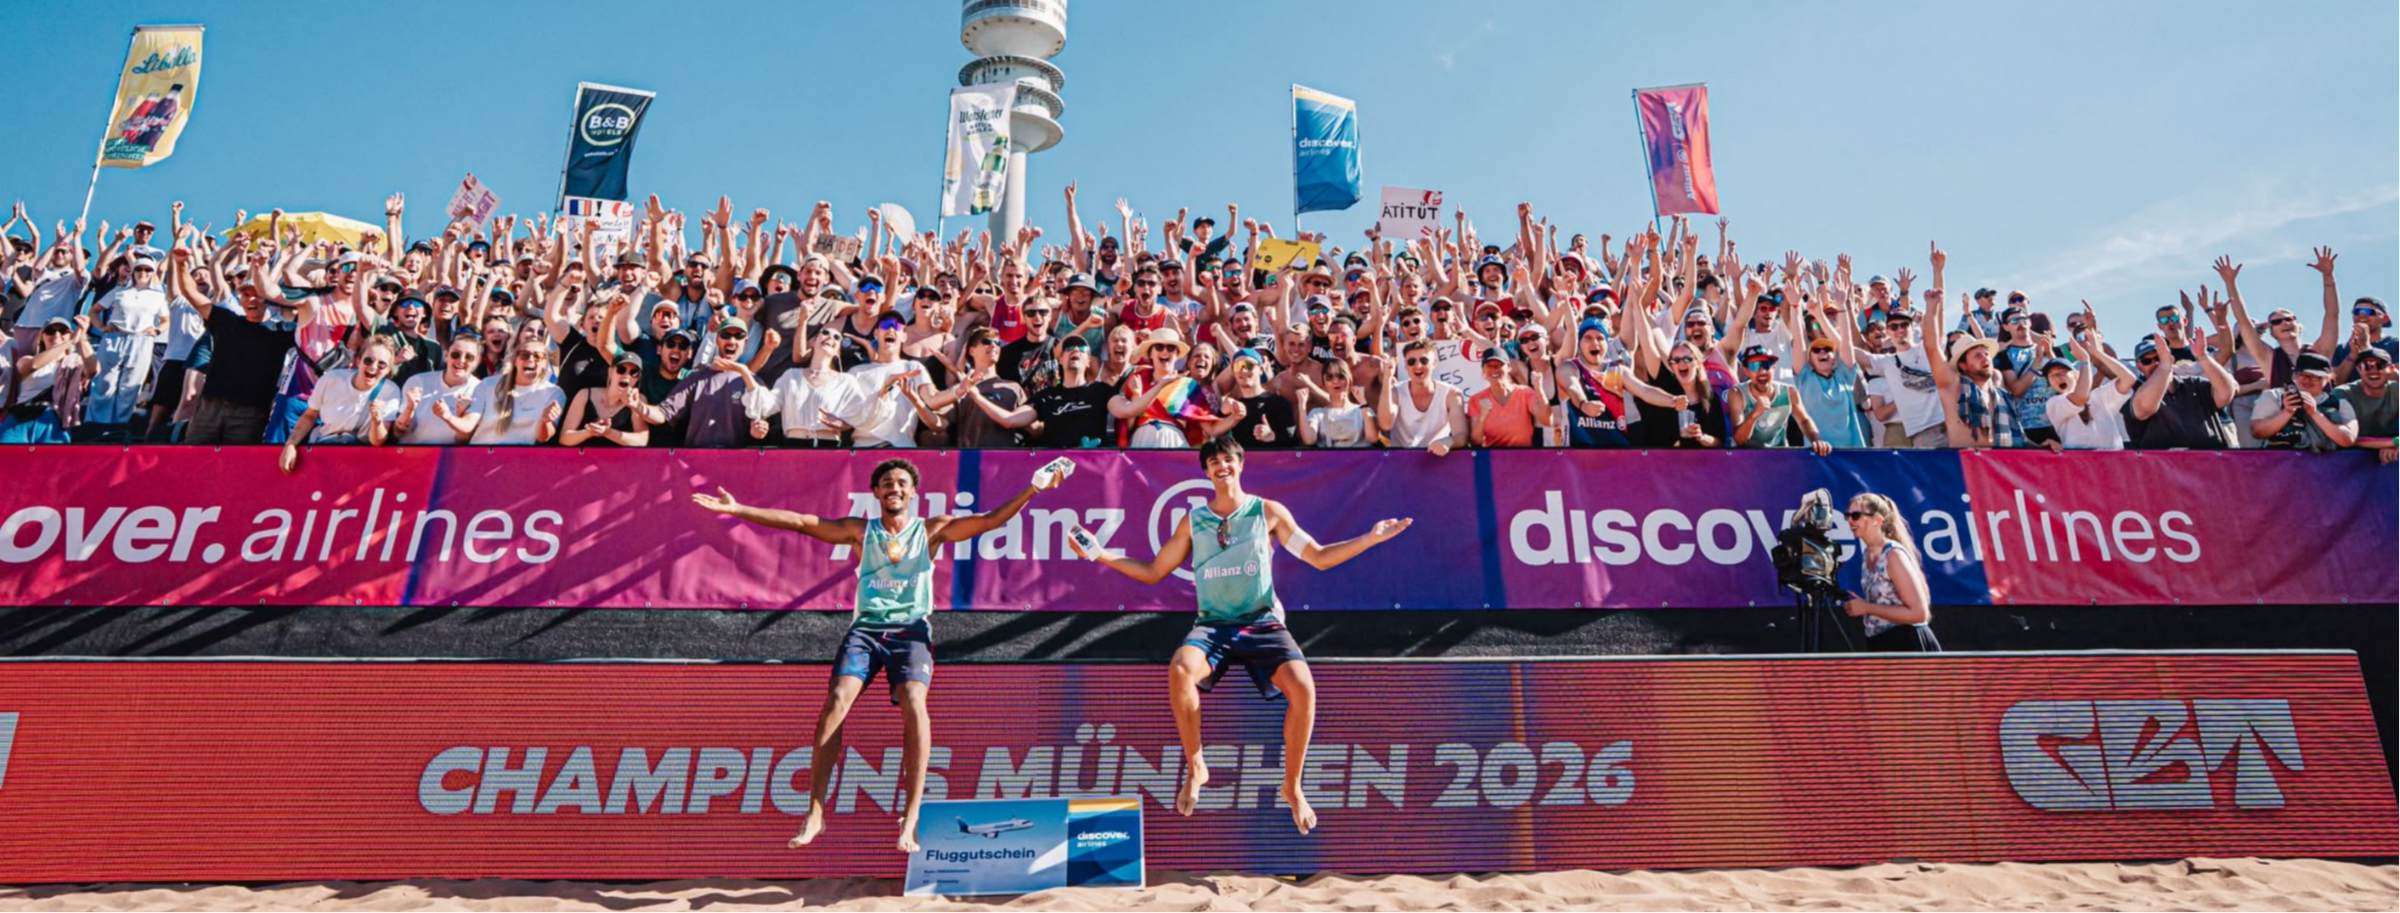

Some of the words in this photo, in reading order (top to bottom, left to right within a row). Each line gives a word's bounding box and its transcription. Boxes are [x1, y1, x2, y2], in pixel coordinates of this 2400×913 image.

[588, 115, 629, 130] B&B
[1299, 148, 1331, 157] airlines
[1683, 163, 1697, 201] Allianz
[1577, 416, 1616, 429] Allianz
[241, 488, 563, 563] airlines
[1921, 489, 2201, 563] airlines
[1203, 566, 1242, 580] Allianz
[976, 723, 1409, 809] MÜNCHEN
[1434, 741, 1635, 808] 2026
[1077, 830, 1130, 841] discover.
[1077, 840, 1107, 848] airlines
[925, 848, 1036, 863] Fluggutschein
